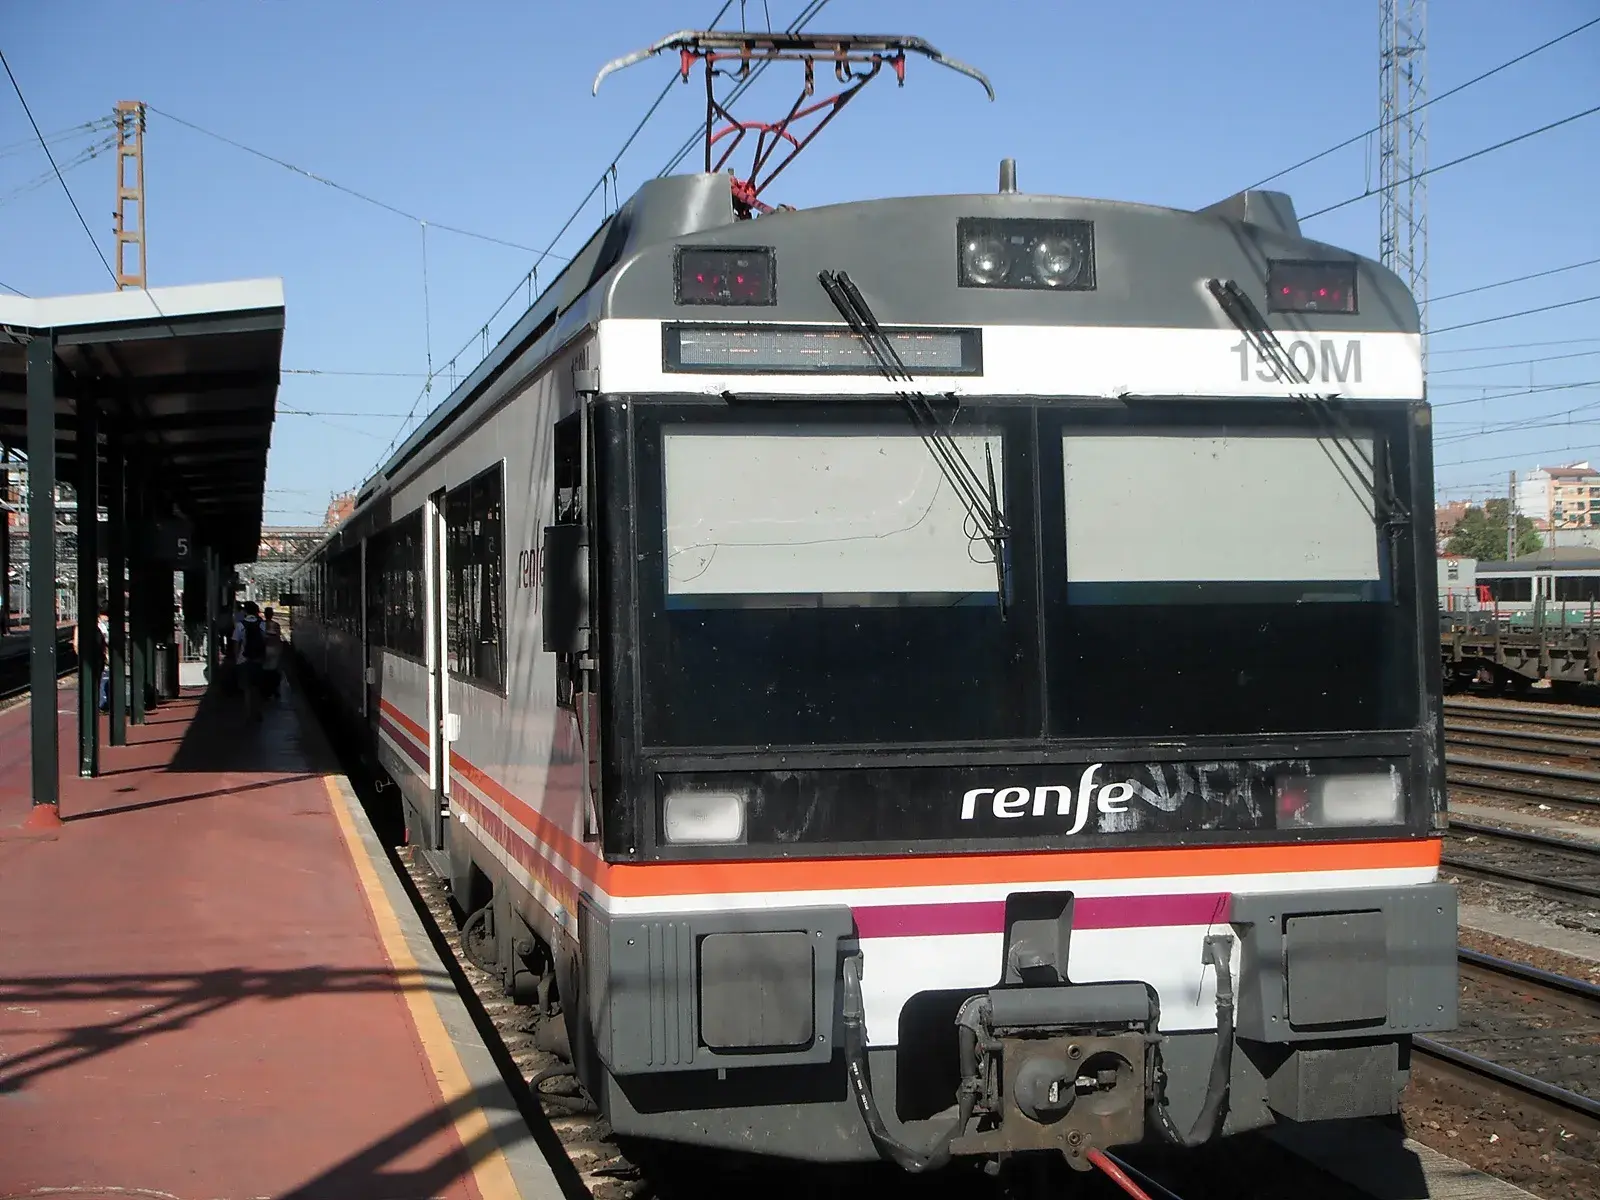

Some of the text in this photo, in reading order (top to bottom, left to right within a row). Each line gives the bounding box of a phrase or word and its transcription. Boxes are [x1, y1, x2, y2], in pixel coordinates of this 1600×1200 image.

[1230, 339, 1362, 383] 150M
[177, 538, 188, 556] 5
[519, 518, 545, 616] renfe
[960, 763, 1135, 836] renfe
